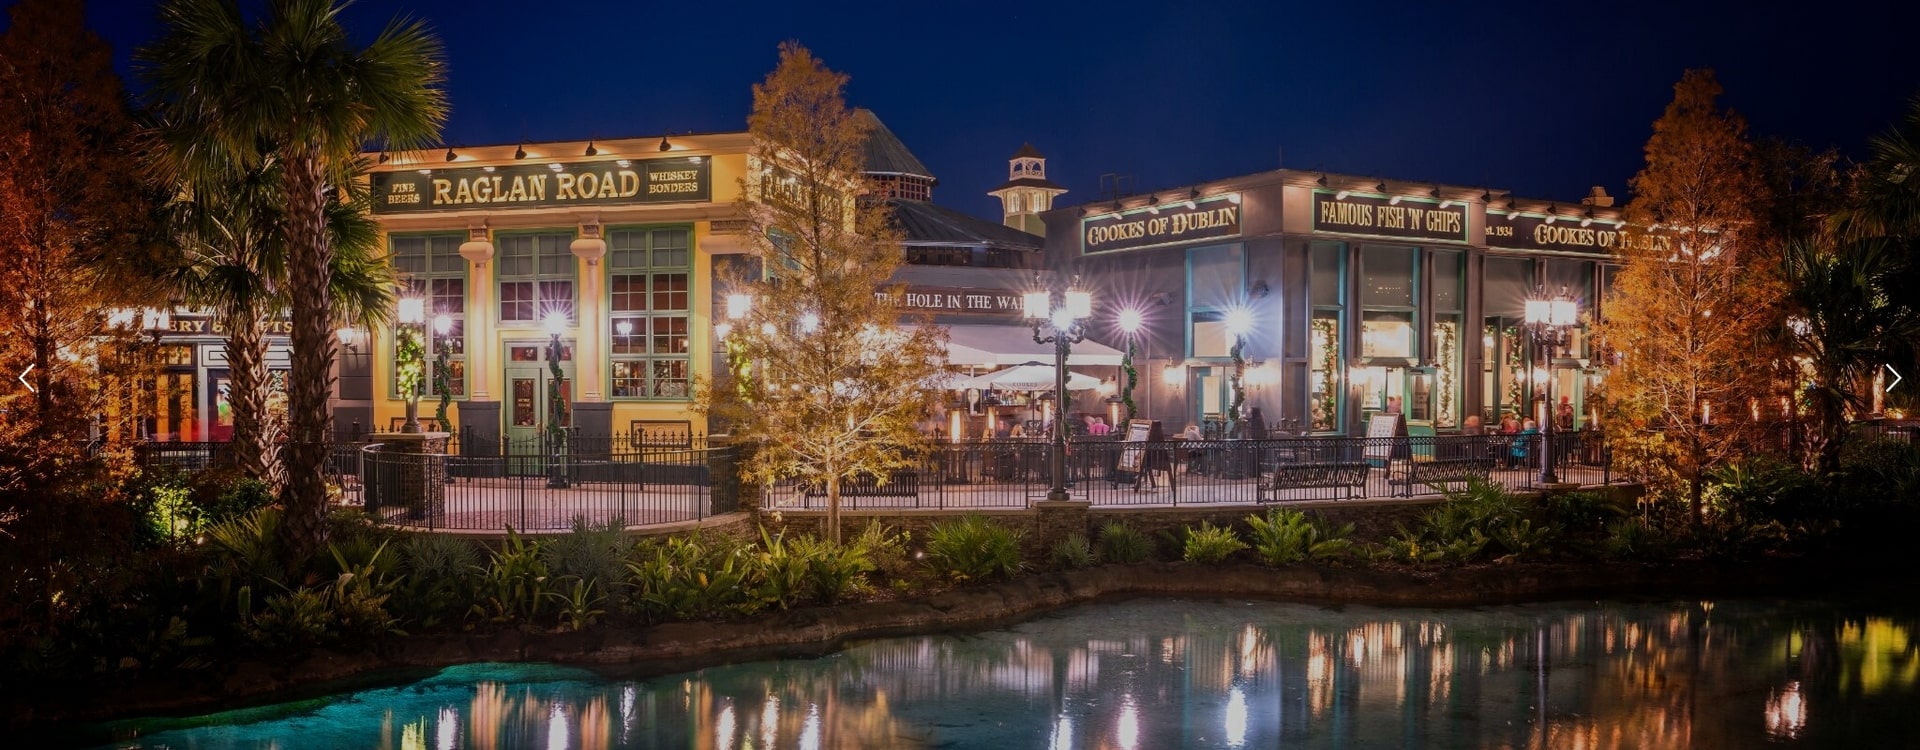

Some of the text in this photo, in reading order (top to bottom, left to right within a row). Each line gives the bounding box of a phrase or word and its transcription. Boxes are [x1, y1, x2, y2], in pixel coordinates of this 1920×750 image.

[649, 170, 698, 182] WHISKEY
[392, 183, 416, 193] FINE
[432, 170, 640, 205] RAGLAN ROAD
[648, 182, 698, 194] BONDERS
[387, 193, 420, 204] BEERS
[1320, 201, 1373, 227] FAMOUS
[1377, 205, 1405, 229] FISH
[1426, 210, 1461, 233] CHIPS
[1087, 207, 1237, 246] COOKES OF DUBLIN
[1534, 224, 1595, 246] COOKES
[1597, 230, 1616, 247] OF
[906, 293, 943, 308] HOLE
[947, 295, 962, 309] IN
[966, 295, 992, 309] THE
